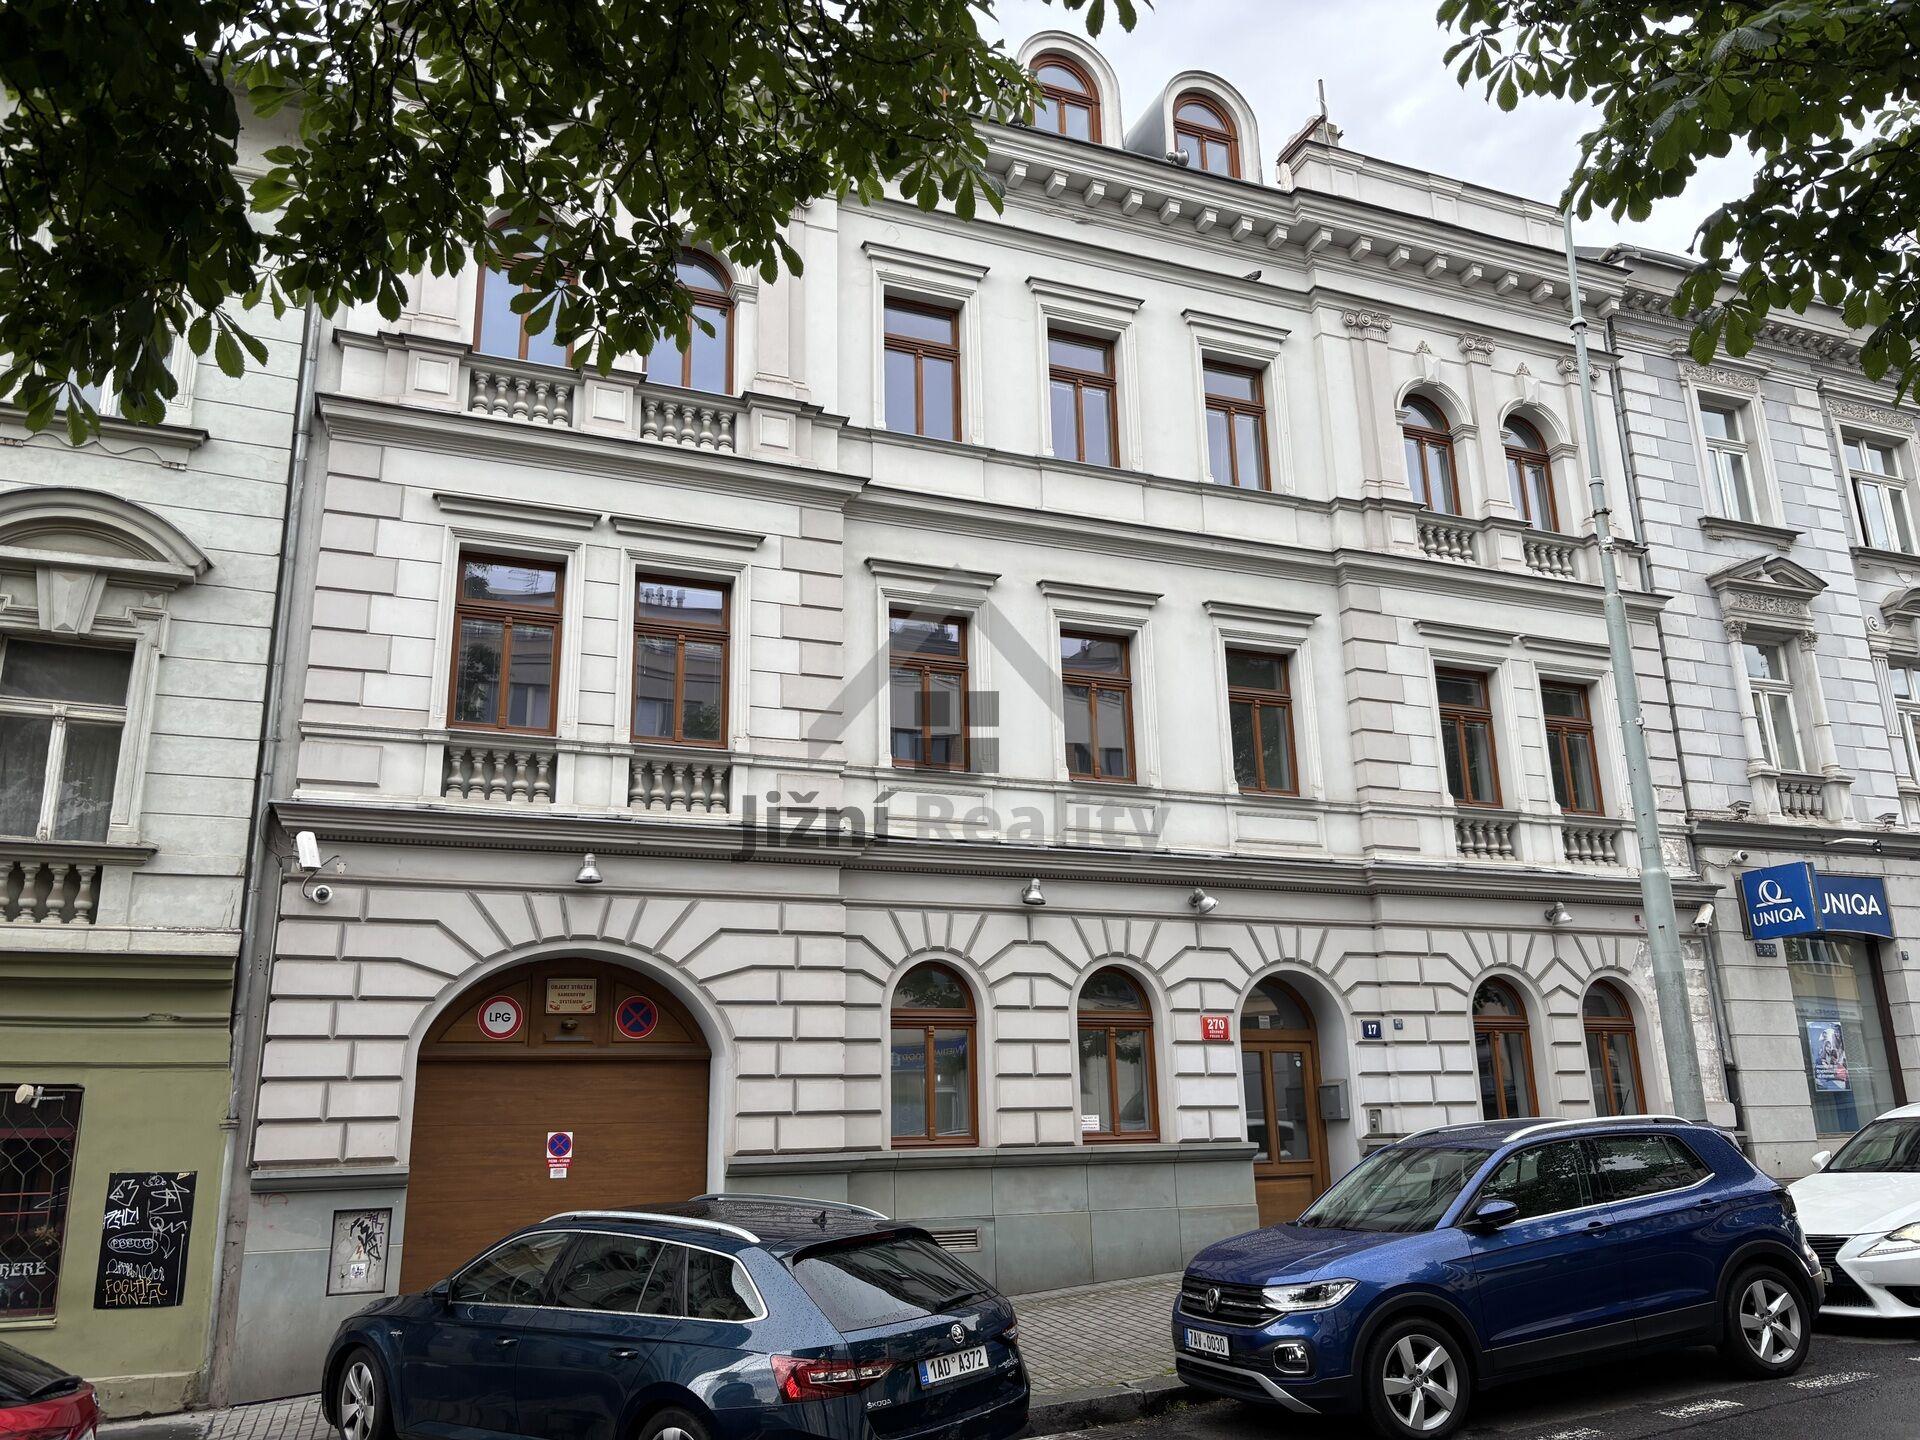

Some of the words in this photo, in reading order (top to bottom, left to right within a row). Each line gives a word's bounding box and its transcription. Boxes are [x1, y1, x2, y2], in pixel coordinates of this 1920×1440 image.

[1752, 906, 1806, 927] UNIQA
[489, 1012, 512, 1023] LPG
[1206, 1018, 1225, 1030] 270
[1367, 1024, 1377, 1035] 17
[930, 1358, 951, 1378] 1AD
[959, 1350, 983, 1372] A372
